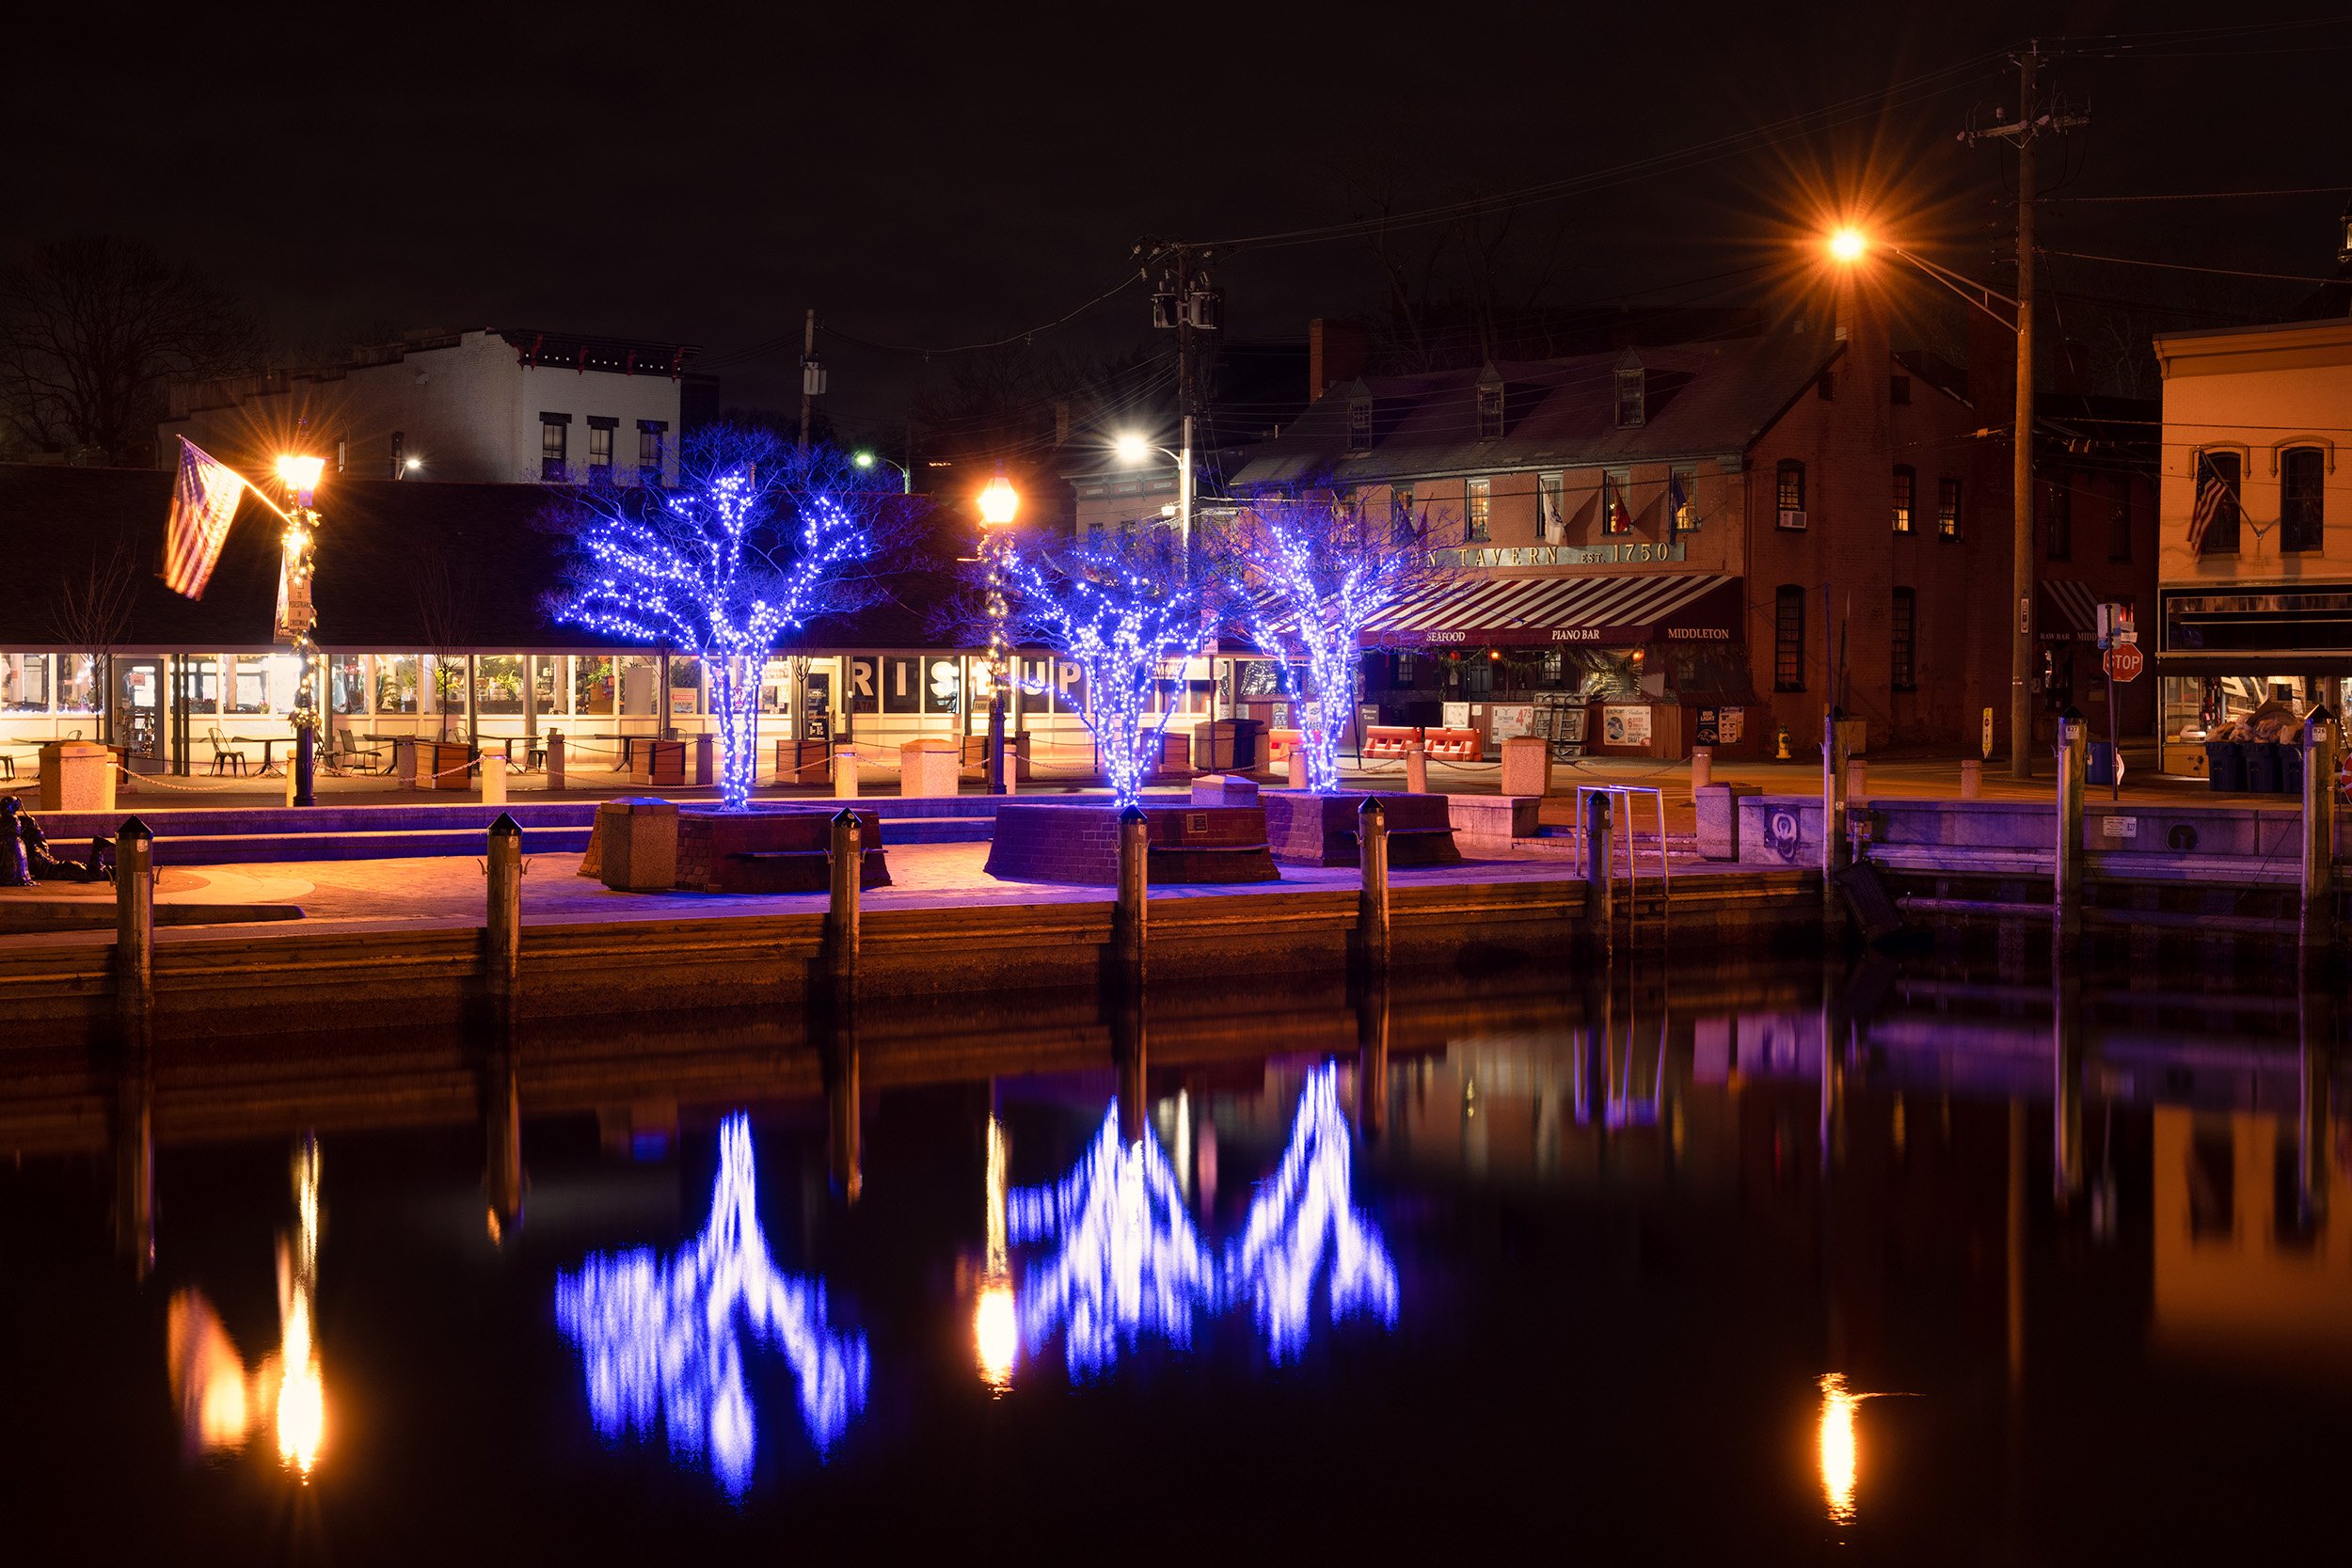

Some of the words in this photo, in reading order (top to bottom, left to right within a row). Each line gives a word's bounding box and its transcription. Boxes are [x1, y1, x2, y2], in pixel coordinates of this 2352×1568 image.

[1458, 546, 1558, 566] TAVERN
[1581, 552, 1606, 563] EST.
[1613, 542, 1670, 562] 1750
[1426, 631, 1466, 641] SEAFOOD
[1552, 630, 1581, 641] PIANO
[1581, 629, 1599, 640] BAR
[1667, 627, 1729, 640] MIDDLETON
[2040, 632, 2055, 641] RAW
[2056, 632, 2071, 641] BAR
[2106, 654, 2140, 670] STOP
[1024, 661, 1082, 696] UP
[852, 701, 877, 712] ATM
